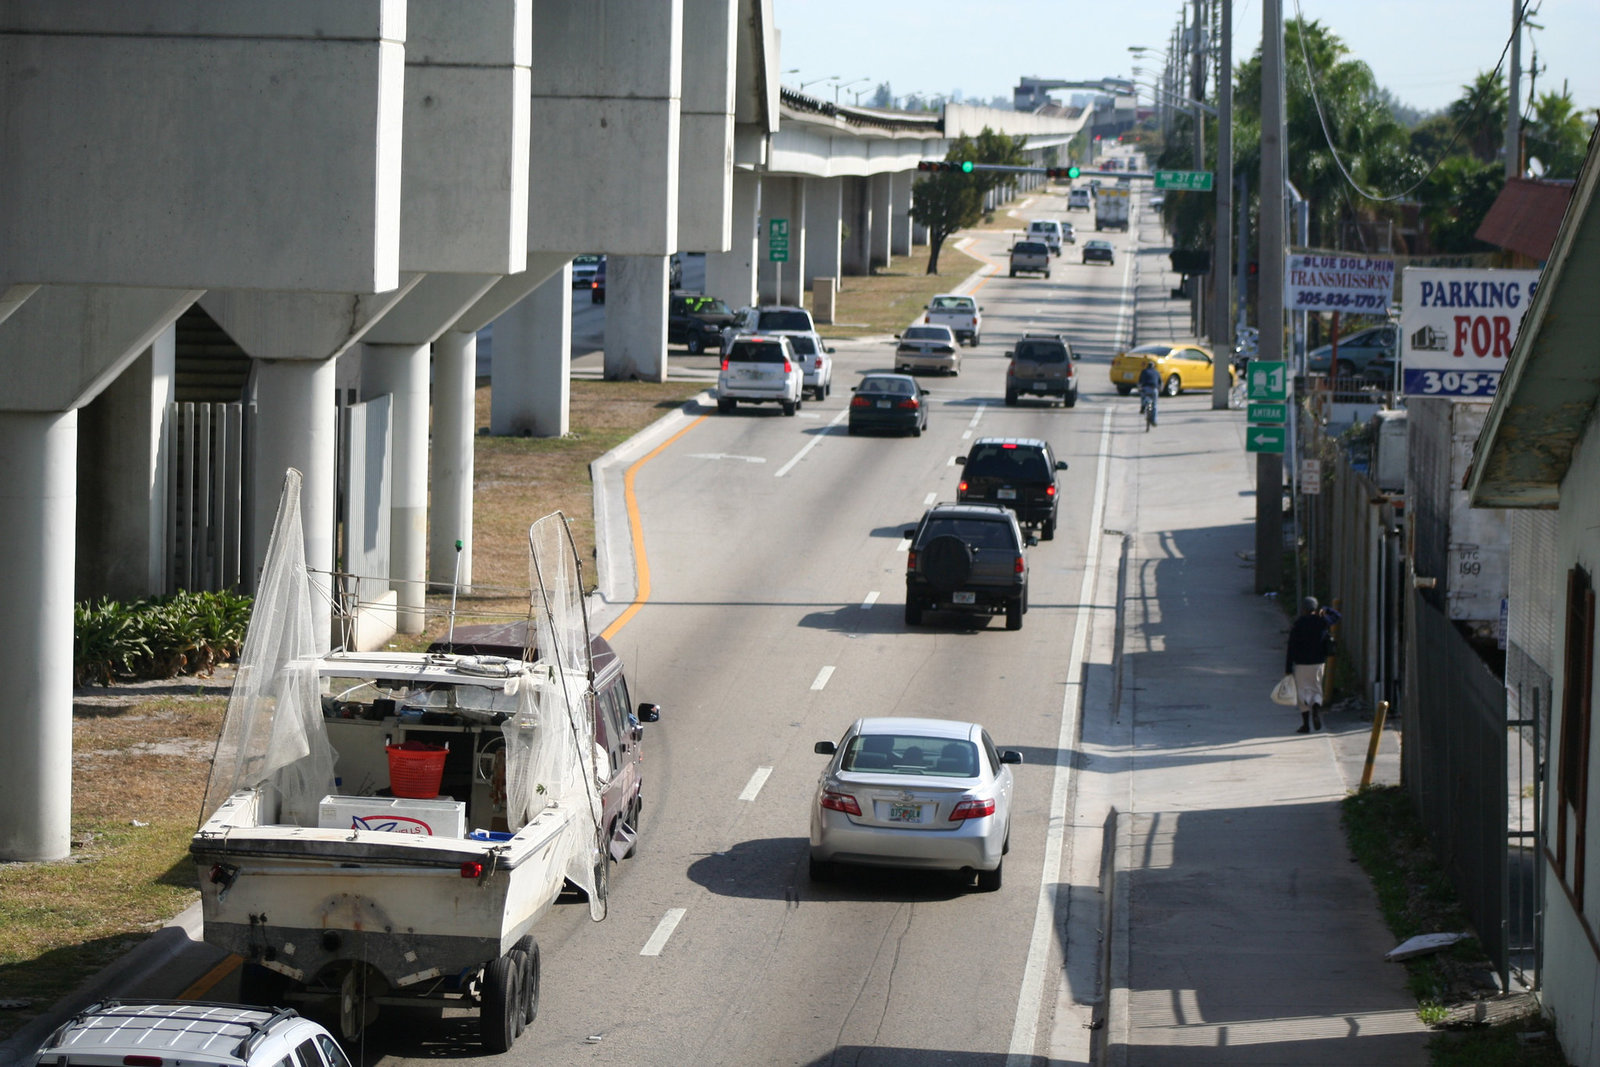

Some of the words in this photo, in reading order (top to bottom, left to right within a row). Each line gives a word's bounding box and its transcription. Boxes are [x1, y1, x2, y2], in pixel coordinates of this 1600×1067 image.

[1176, 172, 1190, 183] 37
[1303, 256, 1337, 268] BLUE
[1340, 258, 1394, 272] DOLPHIN
[1290, 270, 1390, 290] TRANSMISSION
[1297, 291, 1387, 309] 305-836-1707
[1420, 281, 1521, 308] PARKING
[1453, 315, 1513, 358] FOR
[1252, 407, 1282, 418] AMTRAK
[1460, 562, 1481, 575] 199
